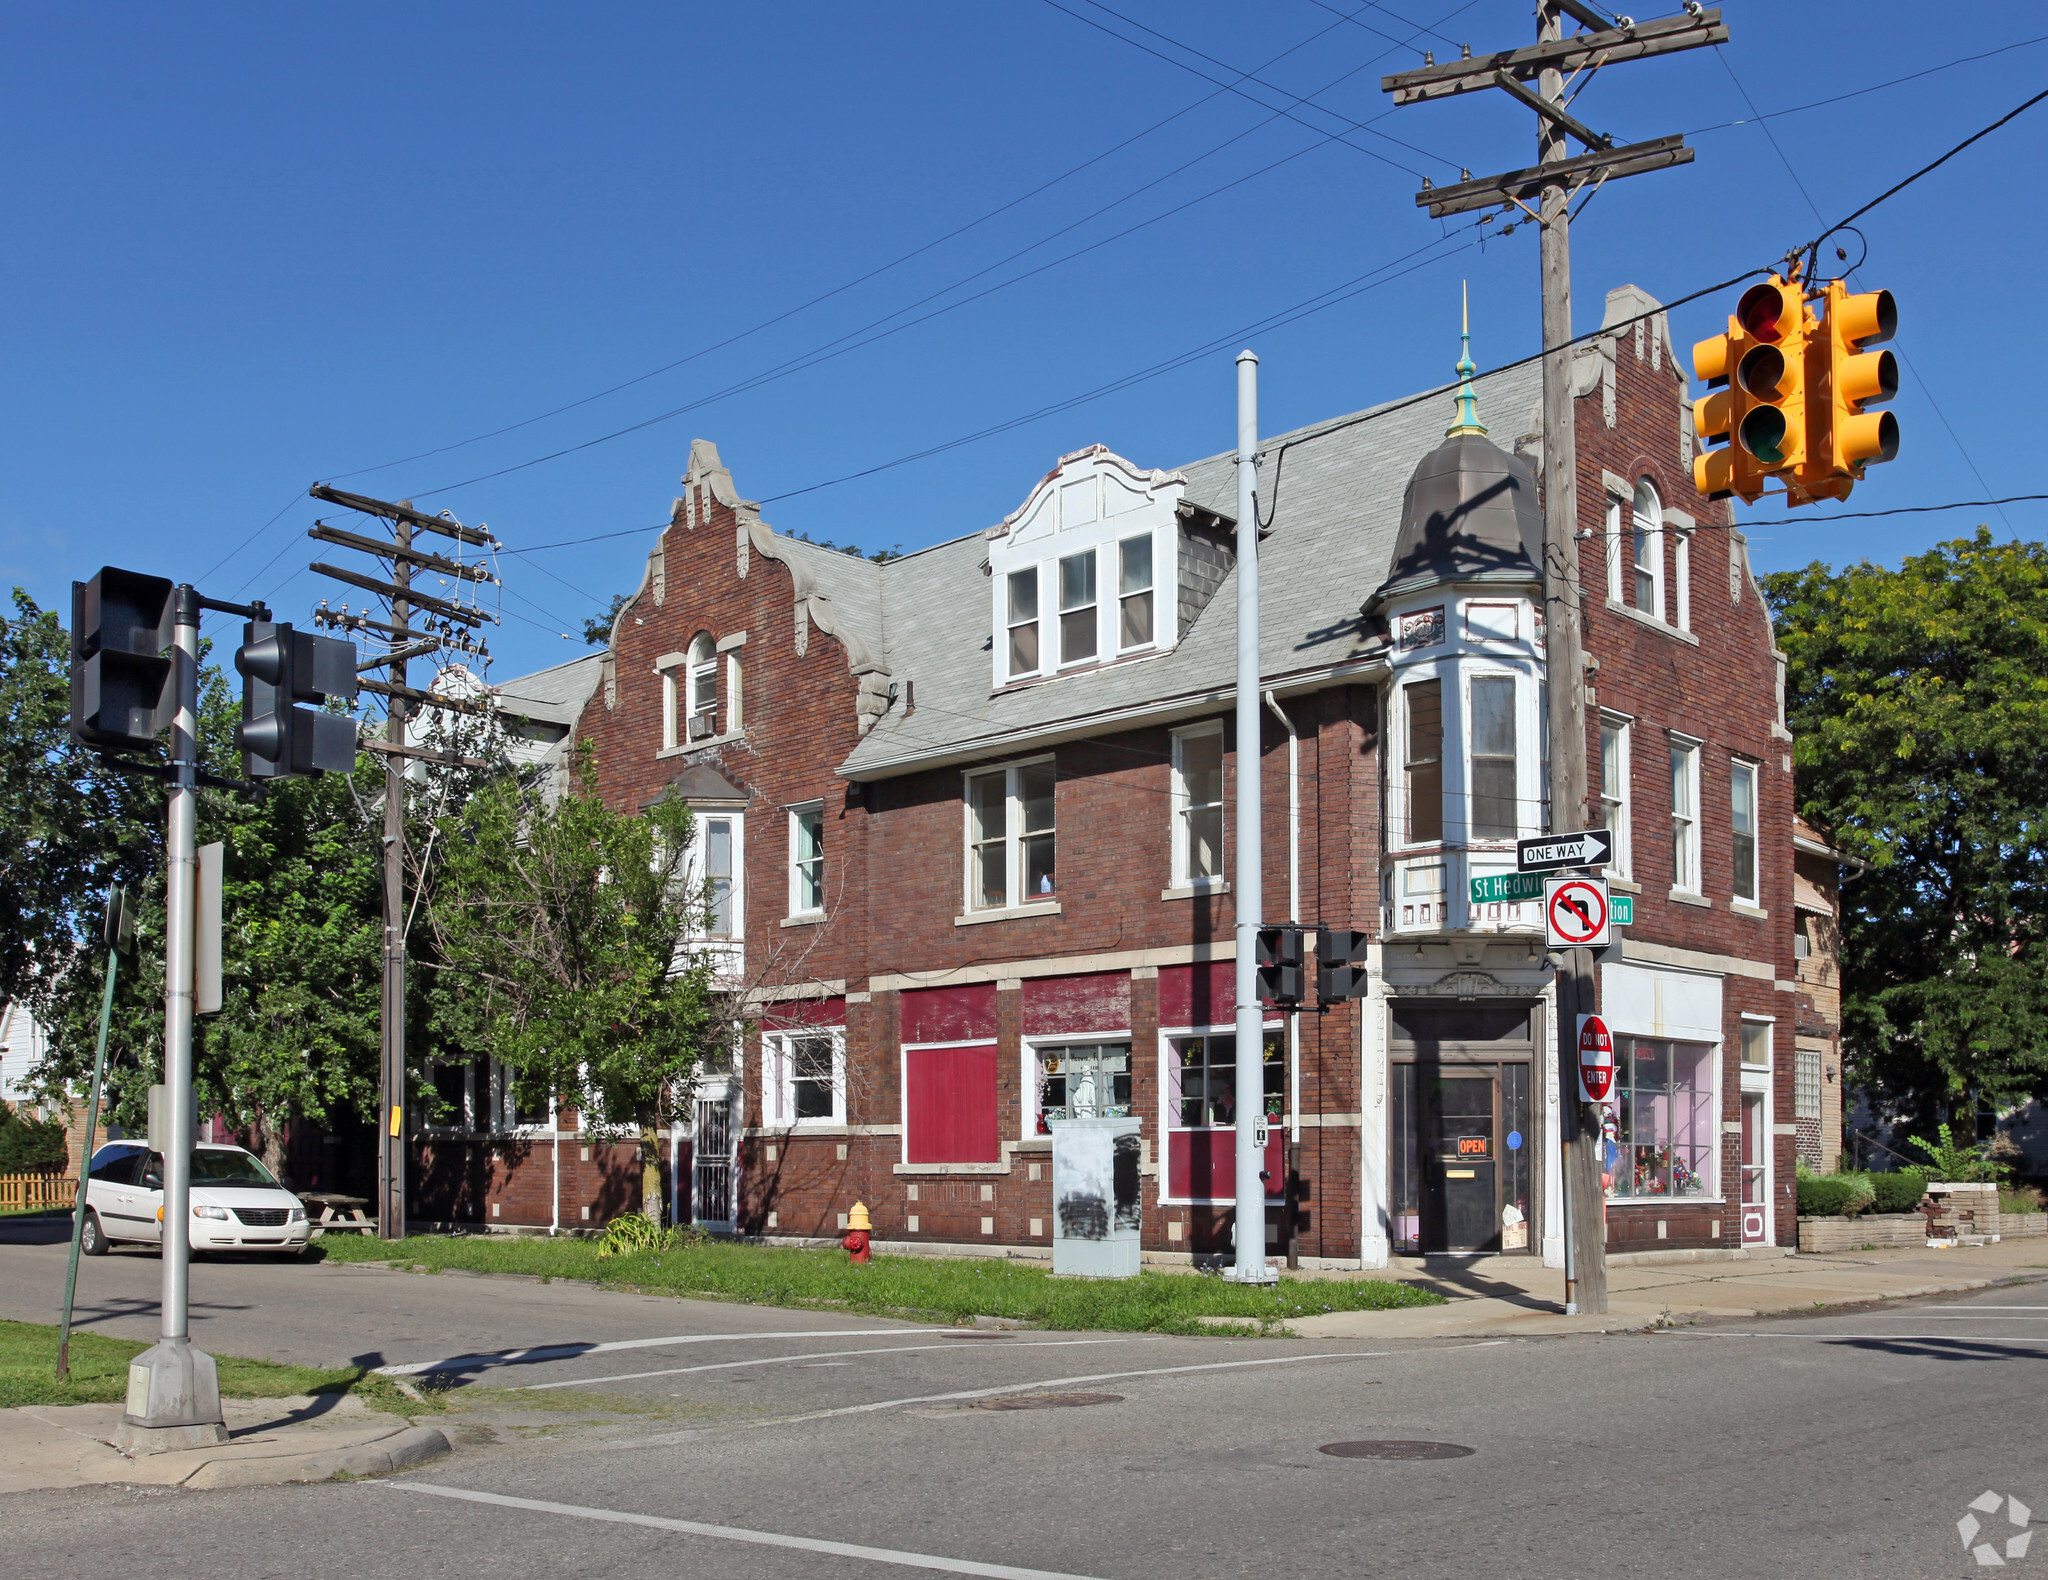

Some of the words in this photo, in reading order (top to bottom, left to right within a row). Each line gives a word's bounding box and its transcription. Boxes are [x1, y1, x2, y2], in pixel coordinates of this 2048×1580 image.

[1526, 846, 1553, 862] ONE
[1556, 842, 1585, 858] WAY
[1475, 879, 1489, 898] St
[1583, 1033, 1592, 1046] DO
[1595, 1033, 1608, 1047] NOT
[1586, 1070, 1608, 1084] ENTER
[1460, 1139, 1486, 1154] OPEN
